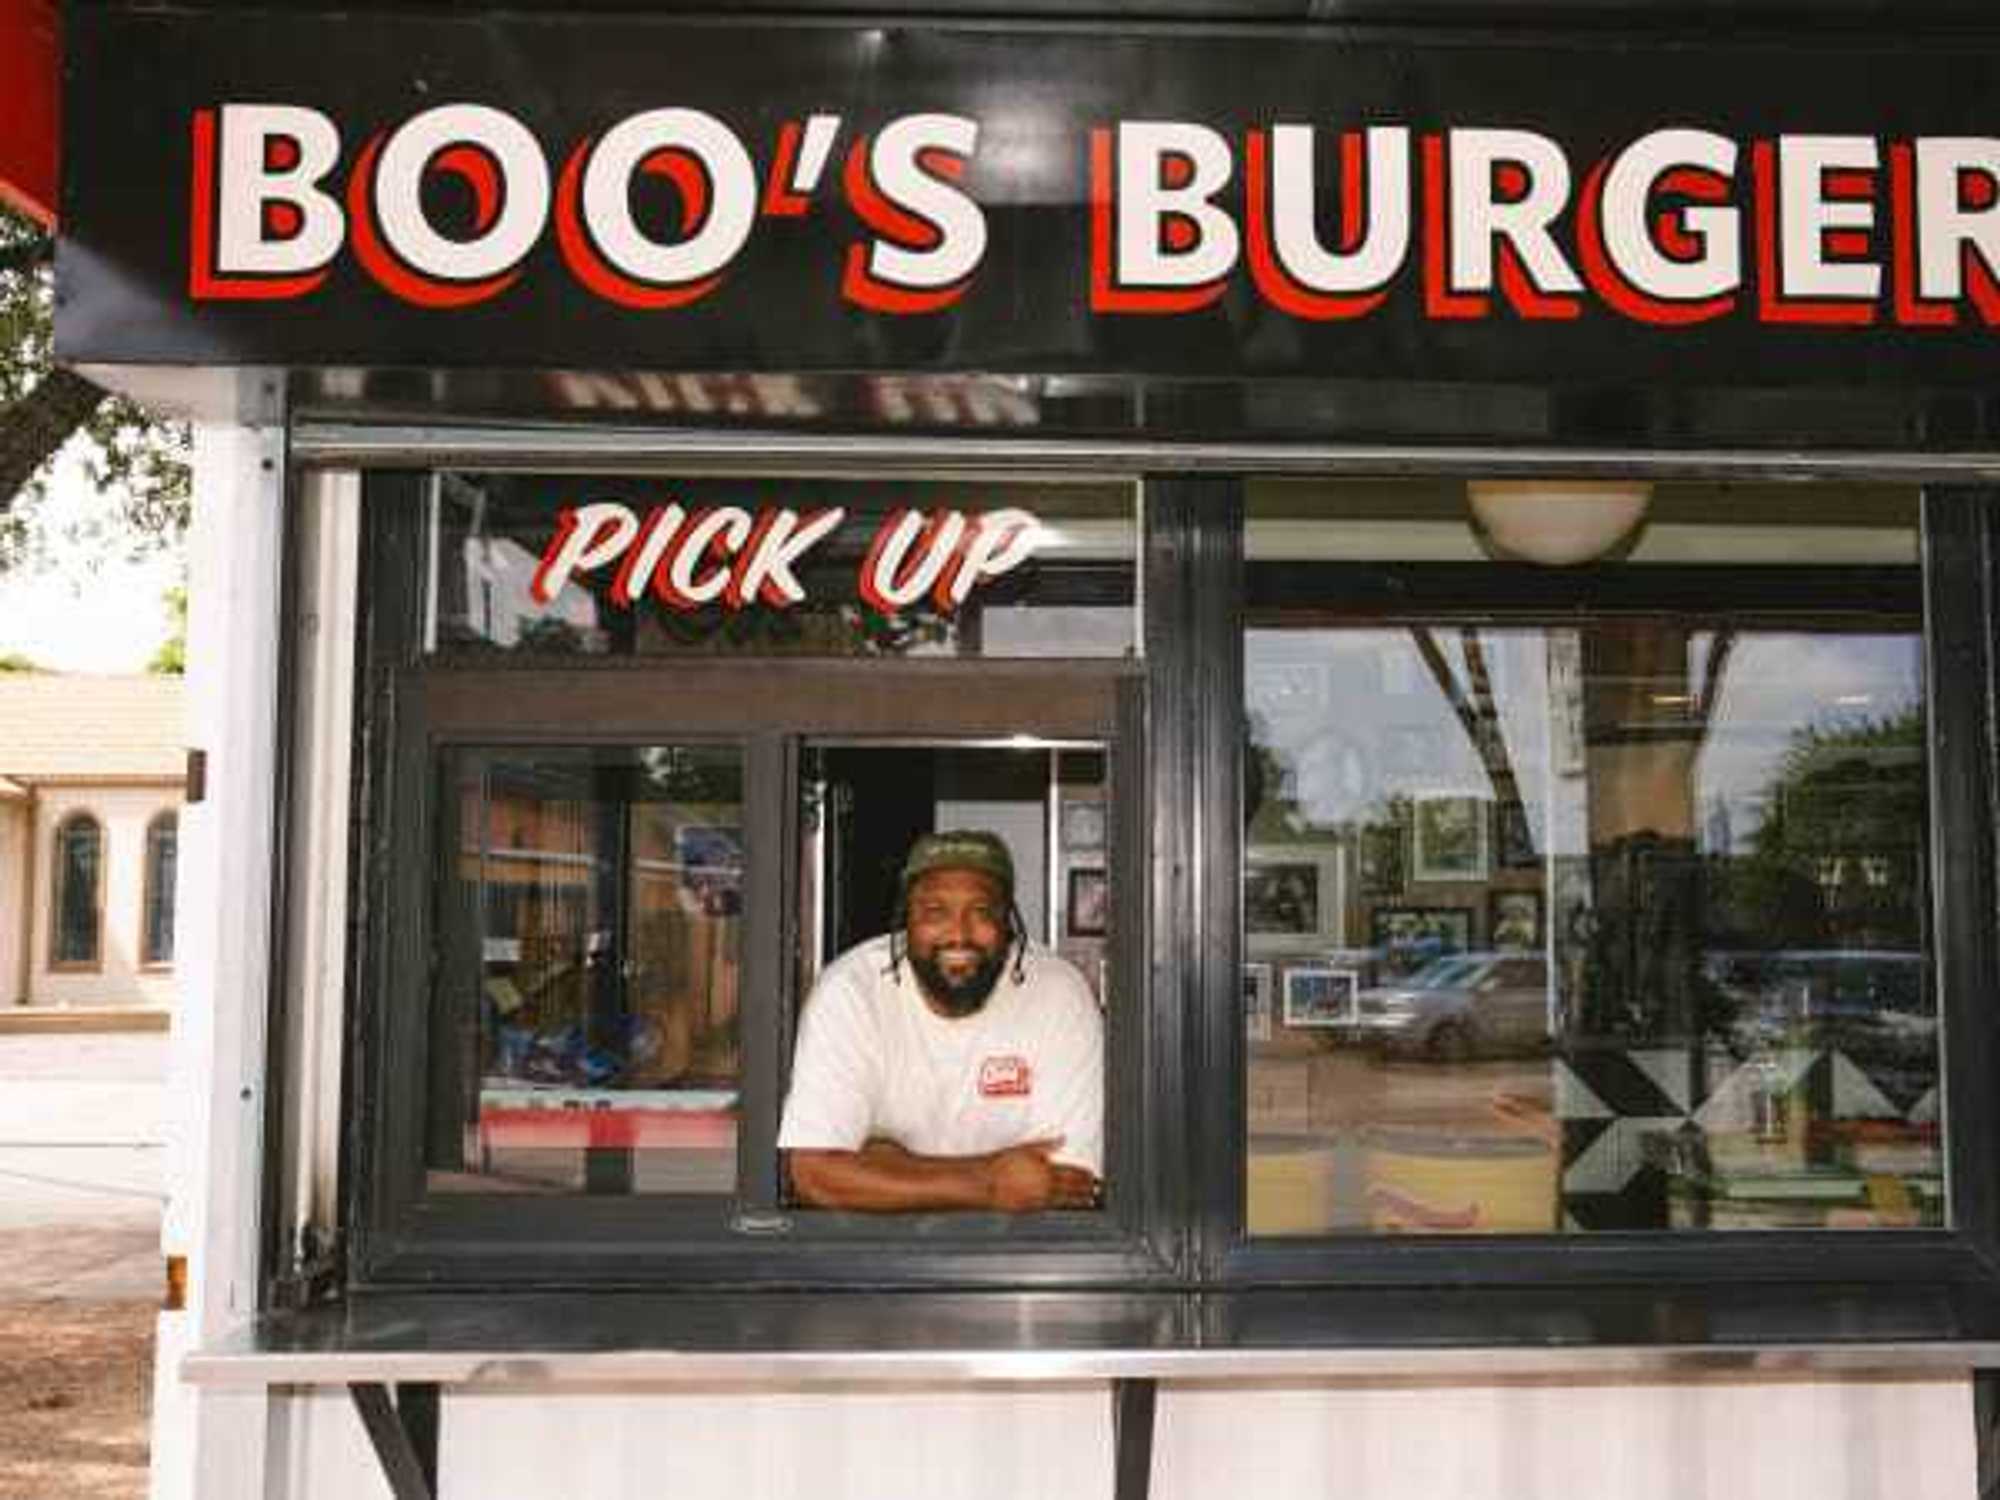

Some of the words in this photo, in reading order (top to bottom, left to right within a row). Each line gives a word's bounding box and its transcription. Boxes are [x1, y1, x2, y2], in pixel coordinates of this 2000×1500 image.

[190, 103, 989, 313] BOO'S
[530, 503, 844, 609] PICK
[858, 508, 1048, 616] UP
